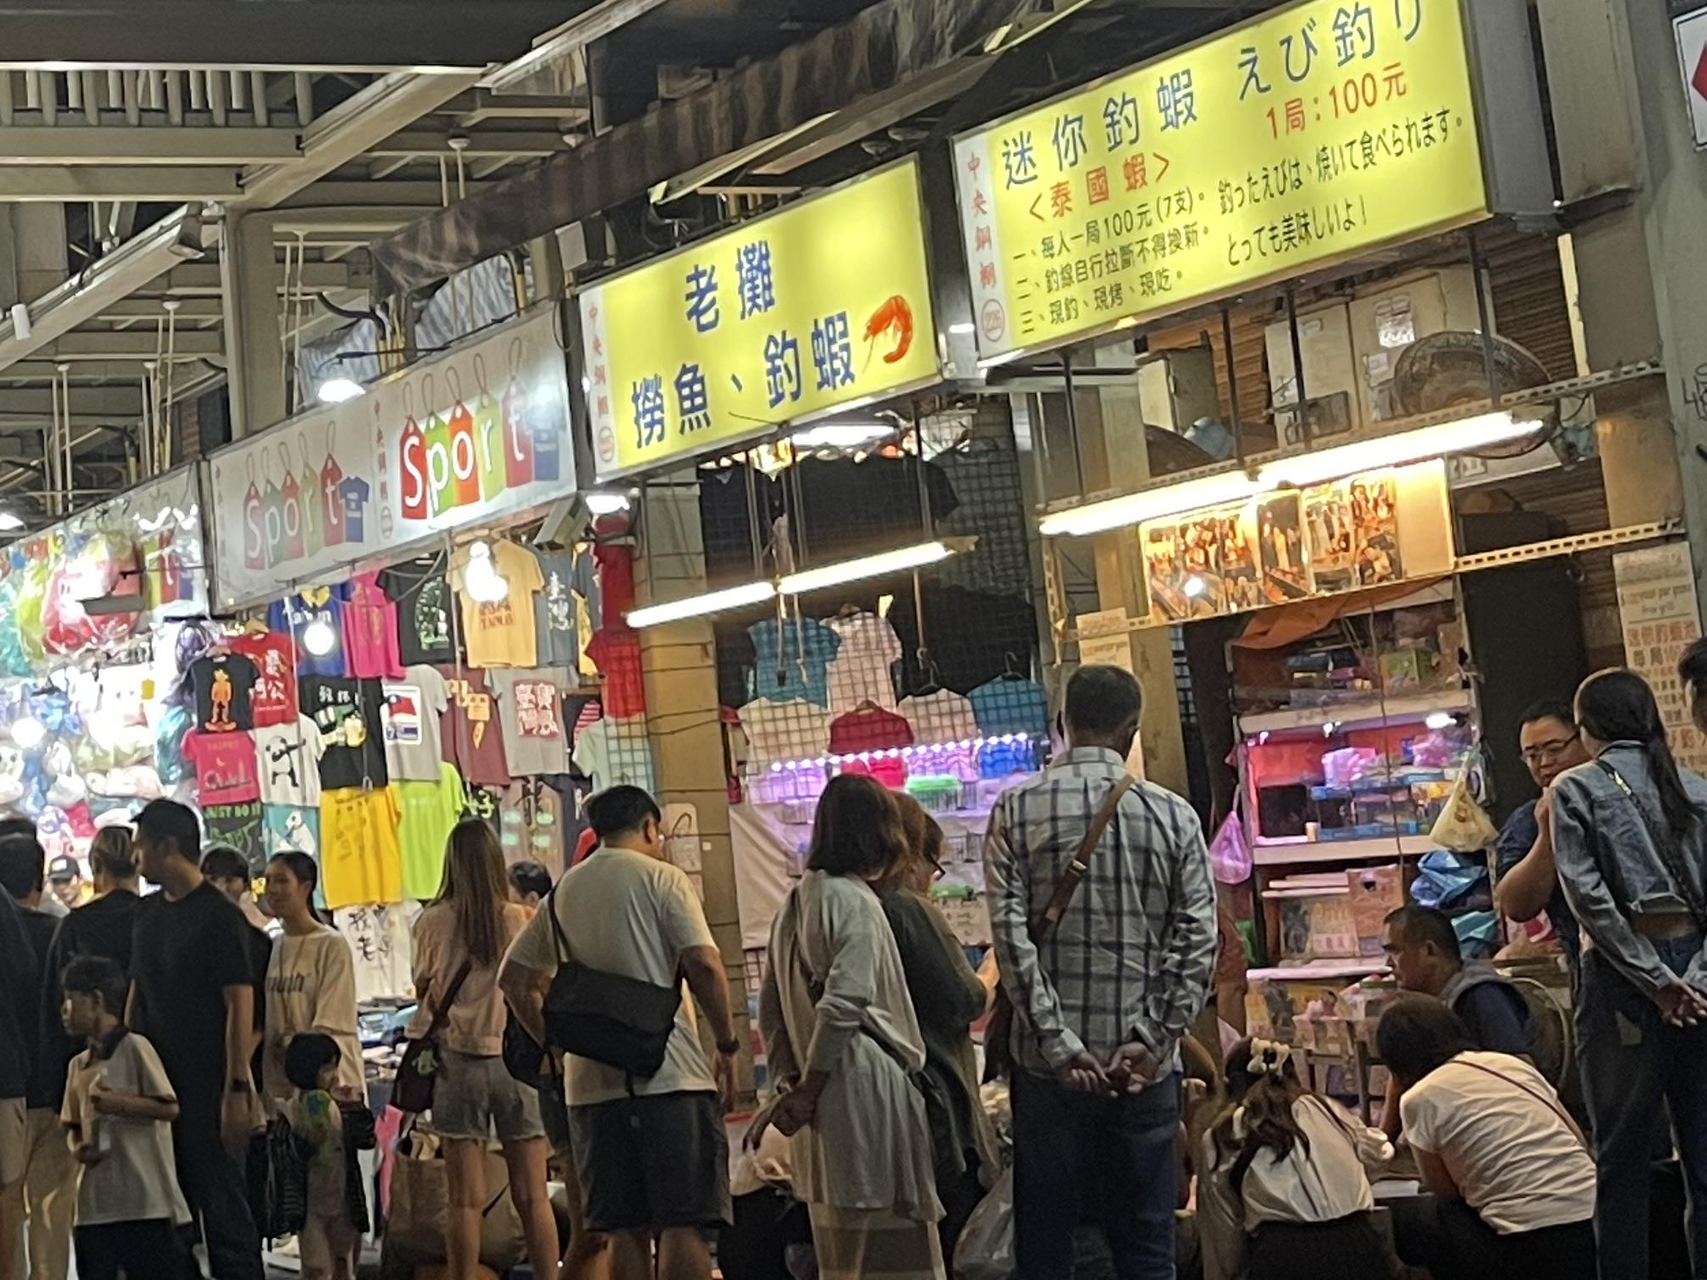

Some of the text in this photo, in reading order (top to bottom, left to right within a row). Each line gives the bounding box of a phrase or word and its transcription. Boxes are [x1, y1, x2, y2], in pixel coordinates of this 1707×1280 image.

[1002, 68, 1197, 190] 迷你釣蝦
[684, 239, 776, 334] 老攤
[631, 310, 856, 449] 撈魚、釣蝦
[403, 401, 526, 513] Sport
[246, 478, 339, 561] Sport
